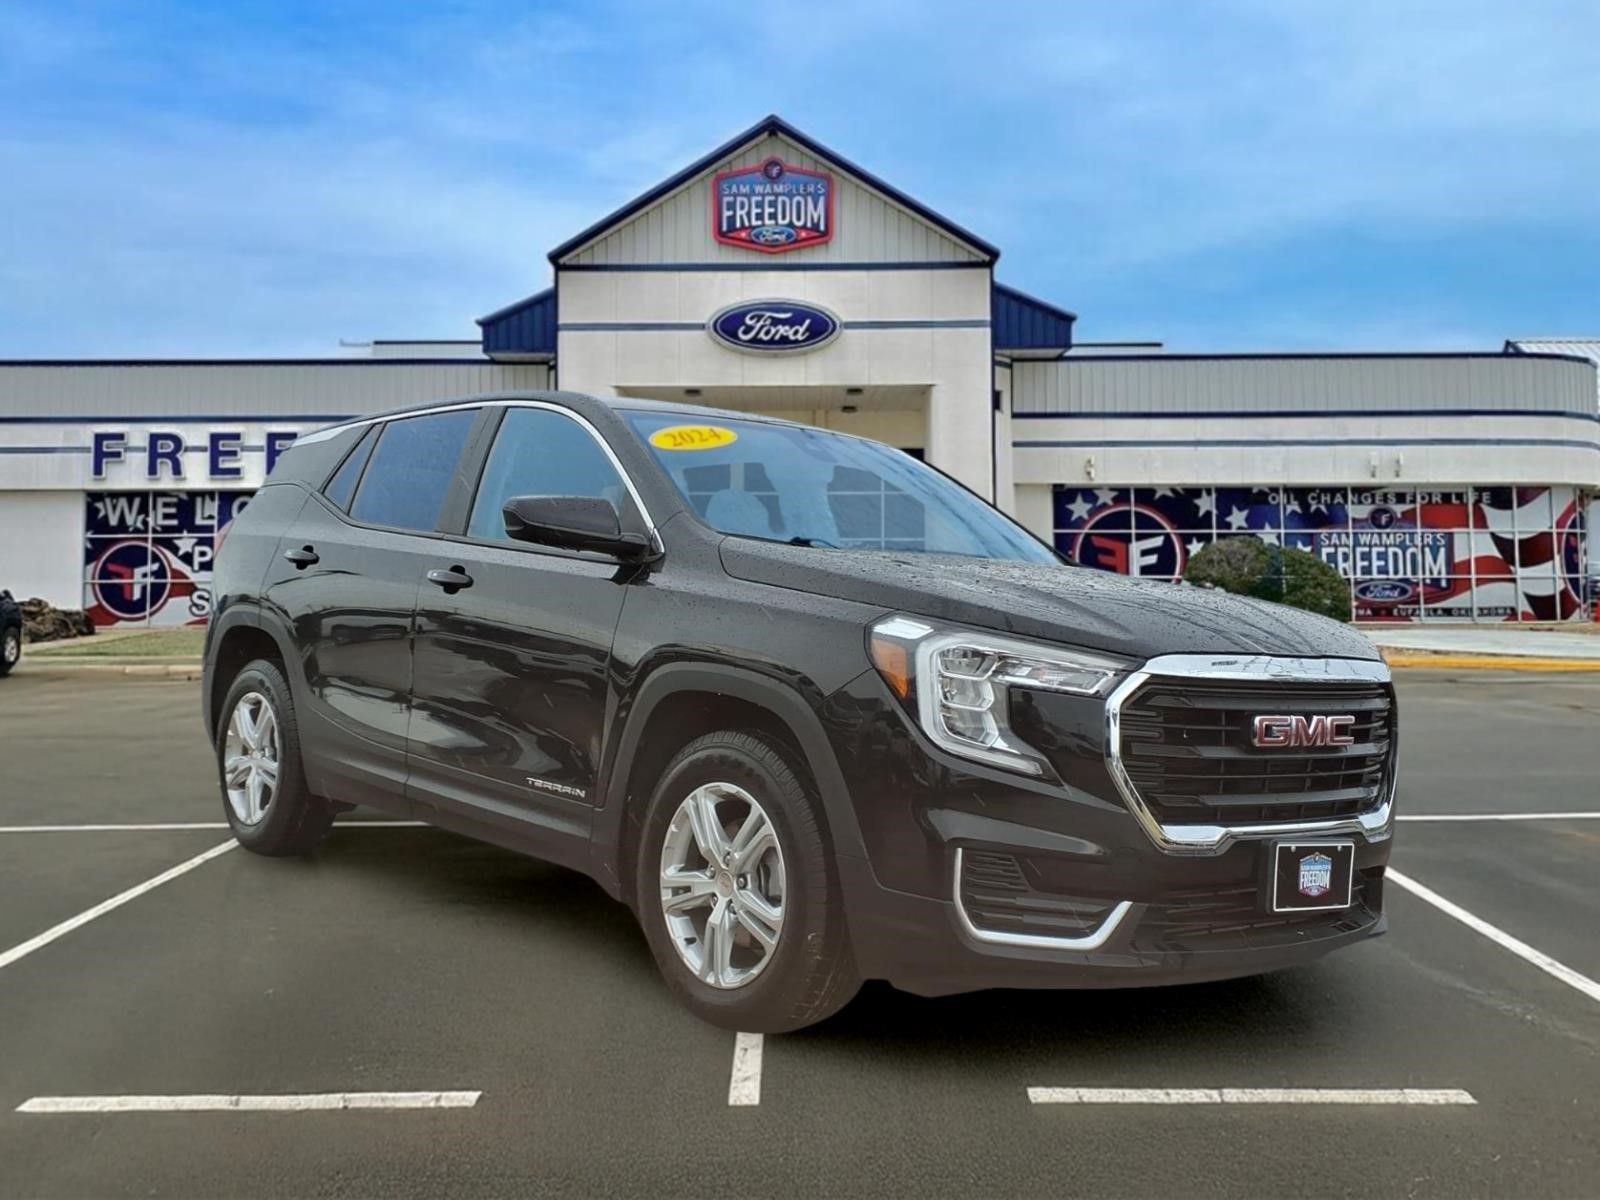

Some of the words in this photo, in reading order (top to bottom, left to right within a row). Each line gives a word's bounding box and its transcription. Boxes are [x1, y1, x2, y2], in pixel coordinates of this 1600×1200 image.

[722, 184, 749, 194] SAM
[722, 195, 825, 232] FREEDOM
[738, 311, 811, 341] Ford
[663, 427, 722, 447] 2024
[1268, 493, 1299, 505] OIL
[1307, 492, 1397, 505] CHANGES
[1406, 492, 1442, 504] FOR
[1451, 491, 1492, 503] LIFE
[1321, 546, 1447, 588] FREEDOM
[1365, 584, 1400, 598] Ford
[1254, 715, 1355, 747] GMC
[526, 777, 586, 797] TERRAIN
[1300, 870, 1330, 890] FREEDOM
